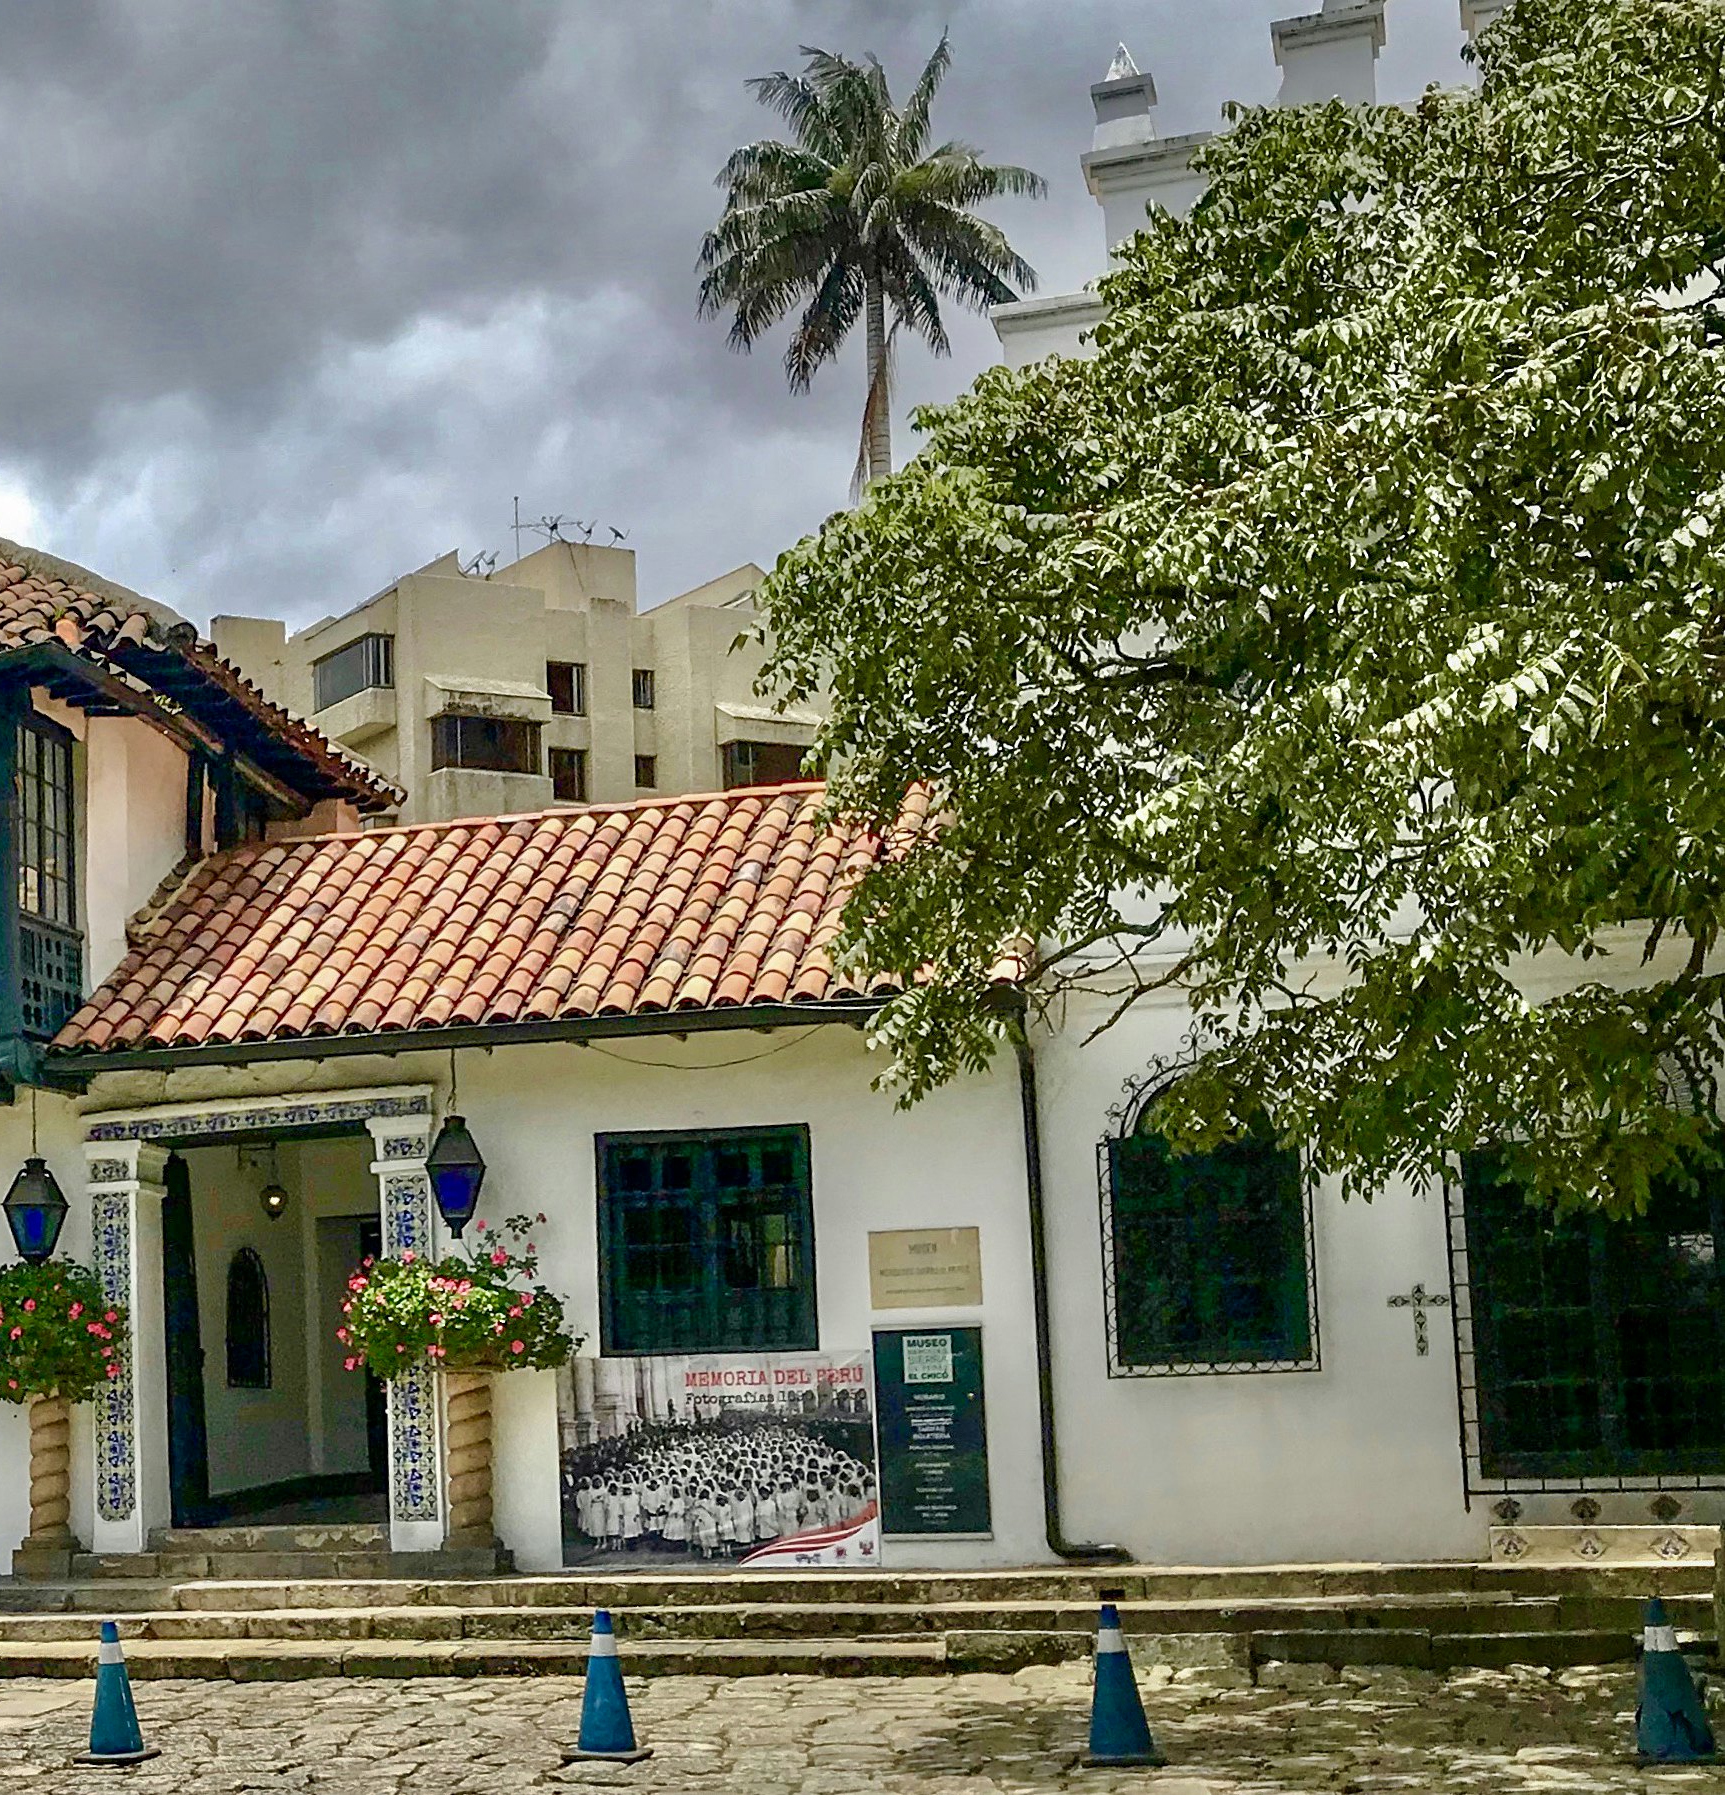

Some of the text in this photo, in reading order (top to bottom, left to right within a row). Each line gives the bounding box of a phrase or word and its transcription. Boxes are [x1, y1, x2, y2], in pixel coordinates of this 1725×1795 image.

[907, 1338, 948, 1348] MUSEO
[685, 1364, 864, 1387] MEMORIA DEL PERÚ
[921, 1370, 949, 1380] CHICÓ
[685, 1391, 774, 1406] Fotografías
